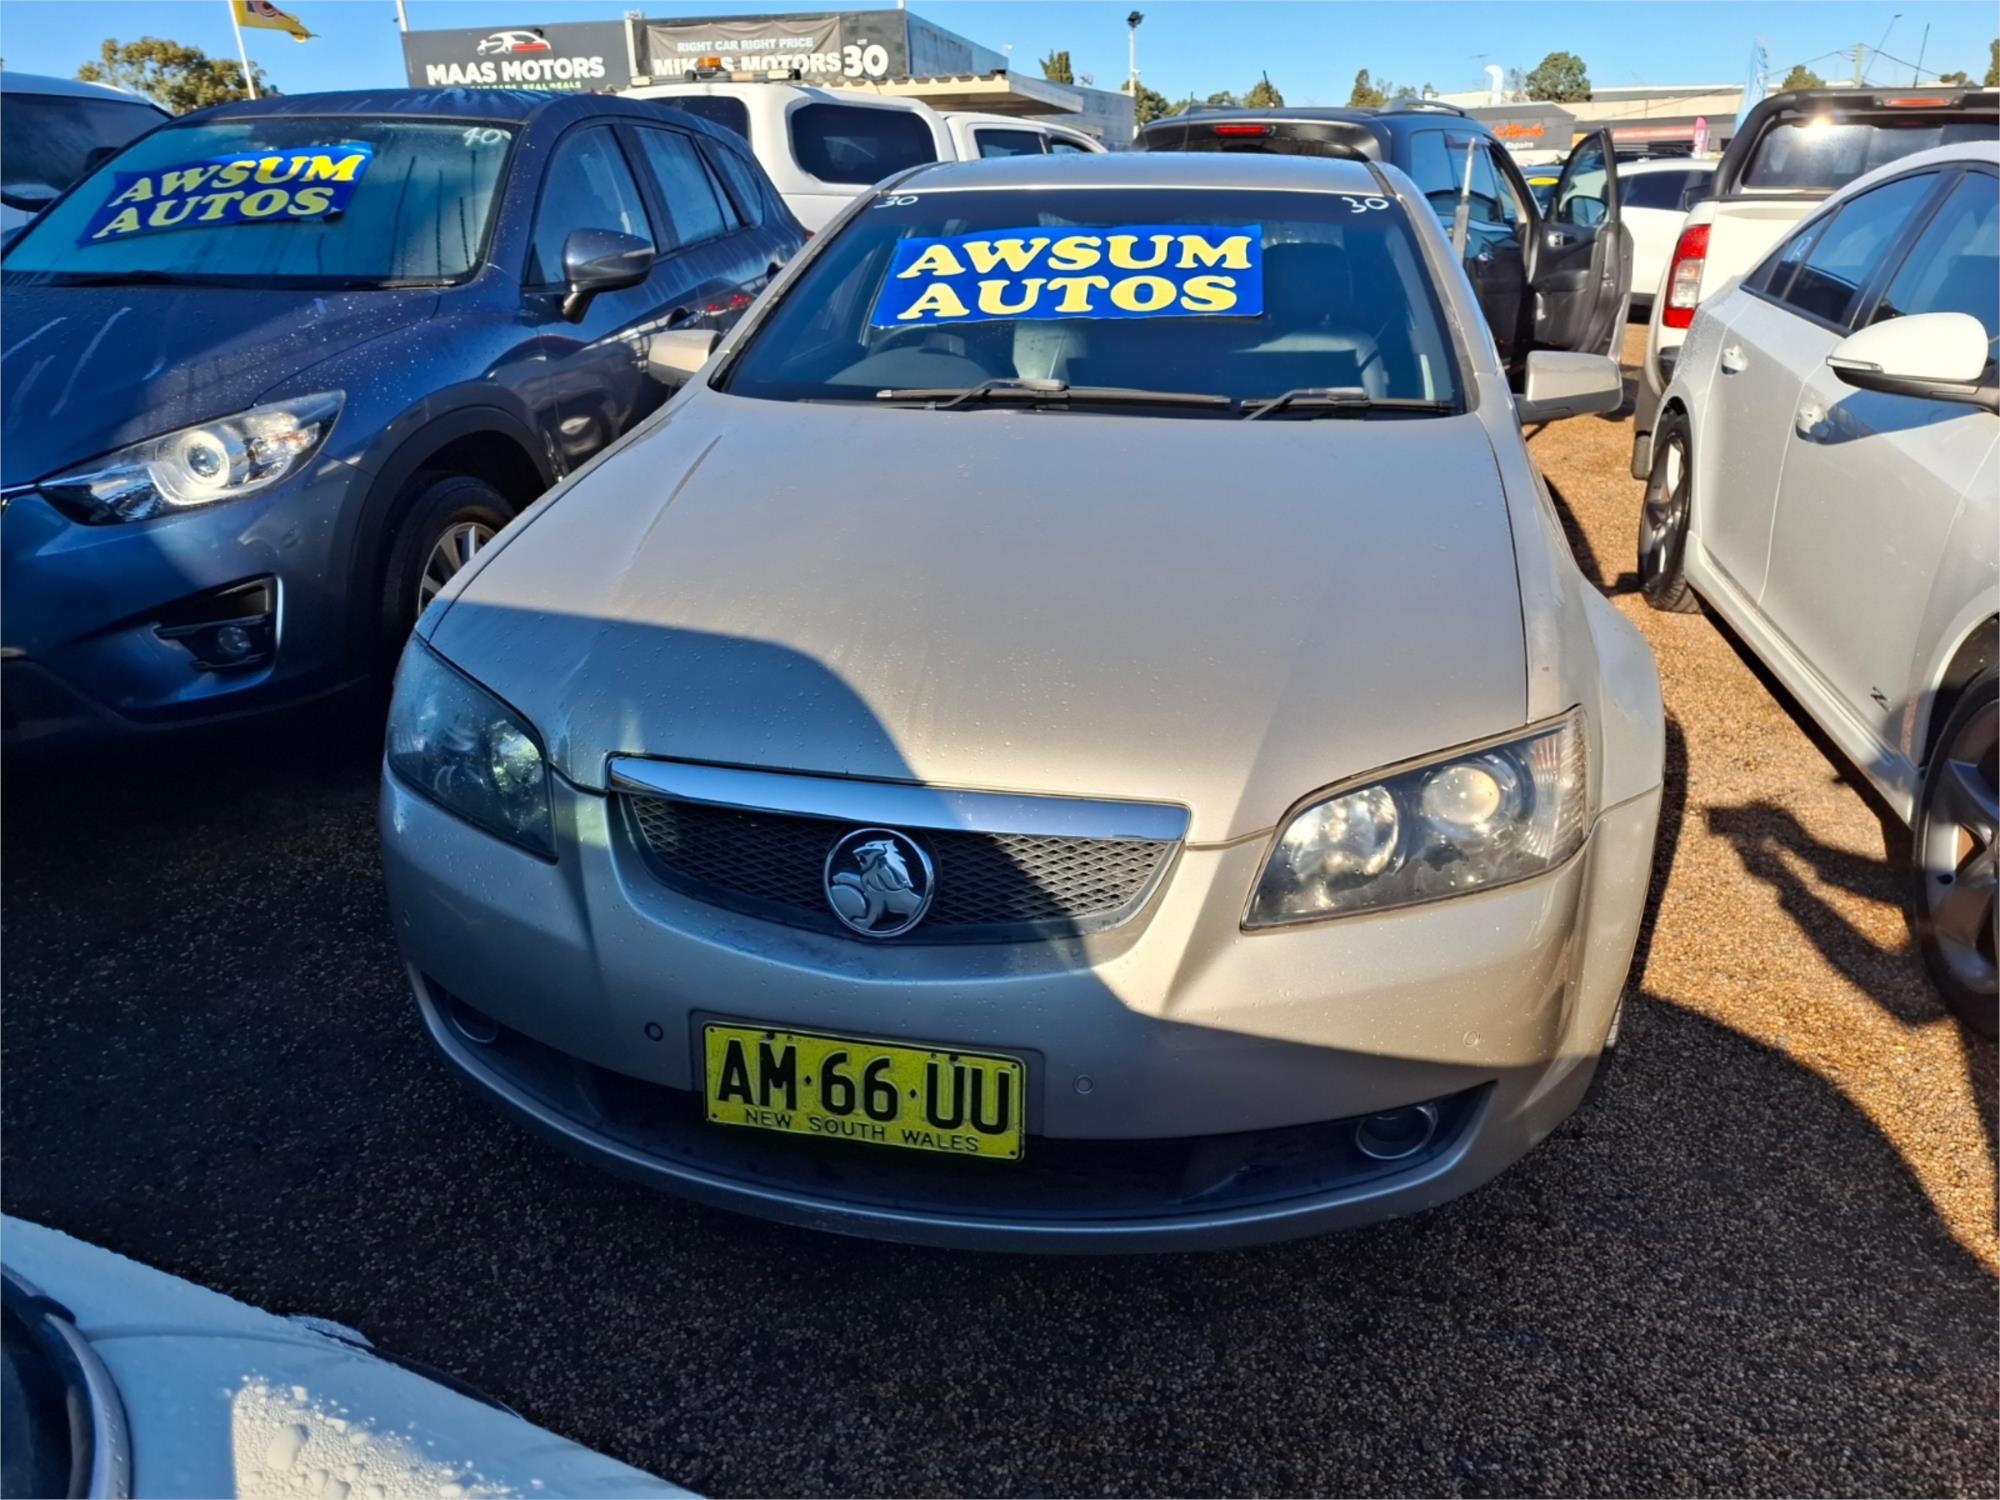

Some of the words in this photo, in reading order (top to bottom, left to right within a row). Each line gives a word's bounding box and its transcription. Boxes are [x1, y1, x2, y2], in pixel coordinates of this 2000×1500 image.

[677, 41, 713, 52] RIGHT
[715, 40, 740, 51] CAR
[741, 38, 777, 50] RIGHT
[779, 37, 814, 49] PRICE
[426, 62, 497, 85] MAAS
[502, 56, 606, 82] MOTORS
[653, 56, 734, 77] MIKS
[741, 52, 842, 75] MOTORS
[843, 45, 889, 77] 30
[108, 154, 365, 208] AWSUM
[92, 187, 335, 239] AUTOS
[873, 195, 919, 209] 30
[1341, 196, 1390, 213] 30
[896, 234, 1253, 279] AWSUM
[896, 275, 1237, 320] AUTOS
[745, 1109, 793, 1129] NEW
[808, 1116, 886, 1141] SOUTH
[901, 1129, 980, 1152] WALES
